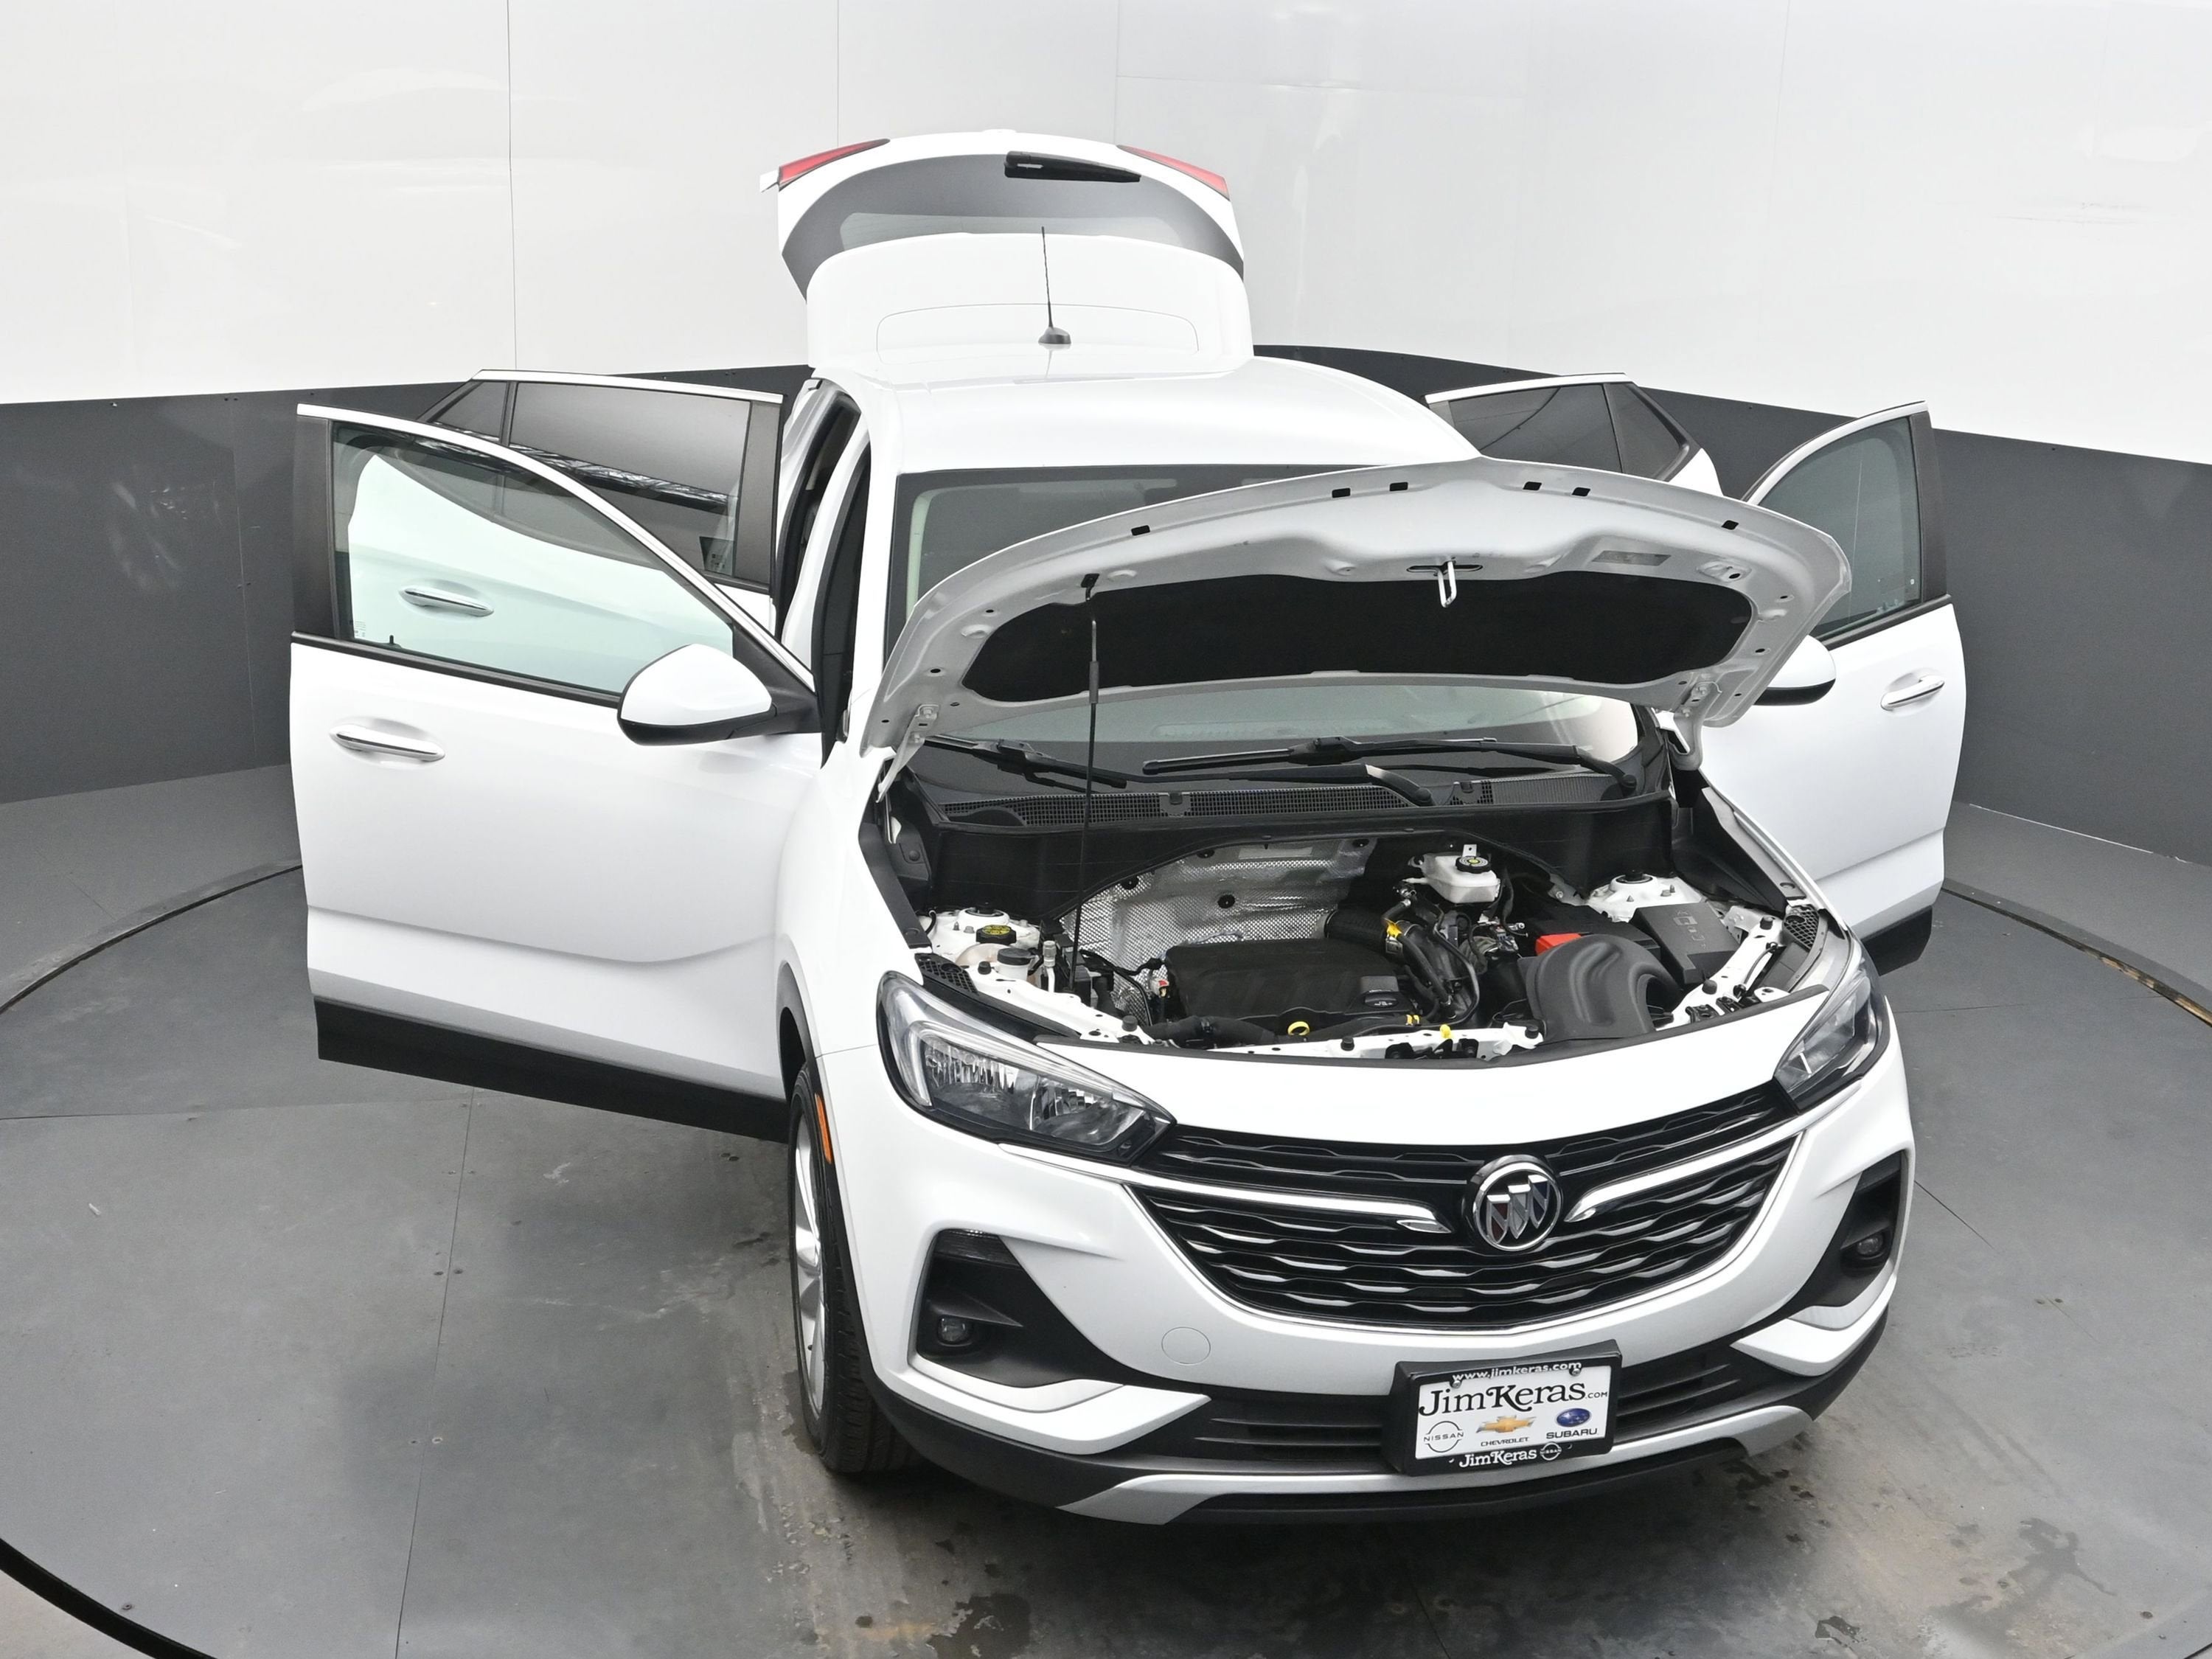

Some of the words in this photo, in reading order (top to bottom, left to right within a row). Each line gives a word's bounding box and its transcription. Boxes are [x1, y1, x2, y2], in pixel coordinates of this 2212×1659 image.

[1452, 1362, 1582, 1381] www.jimkeras.com
[1423, 1432, 1464, 1442] NISSAN
[1545, 1428, 1598, 1439] SUBARU
[1480, 1436, 1530, 1447] CHEVROLET
